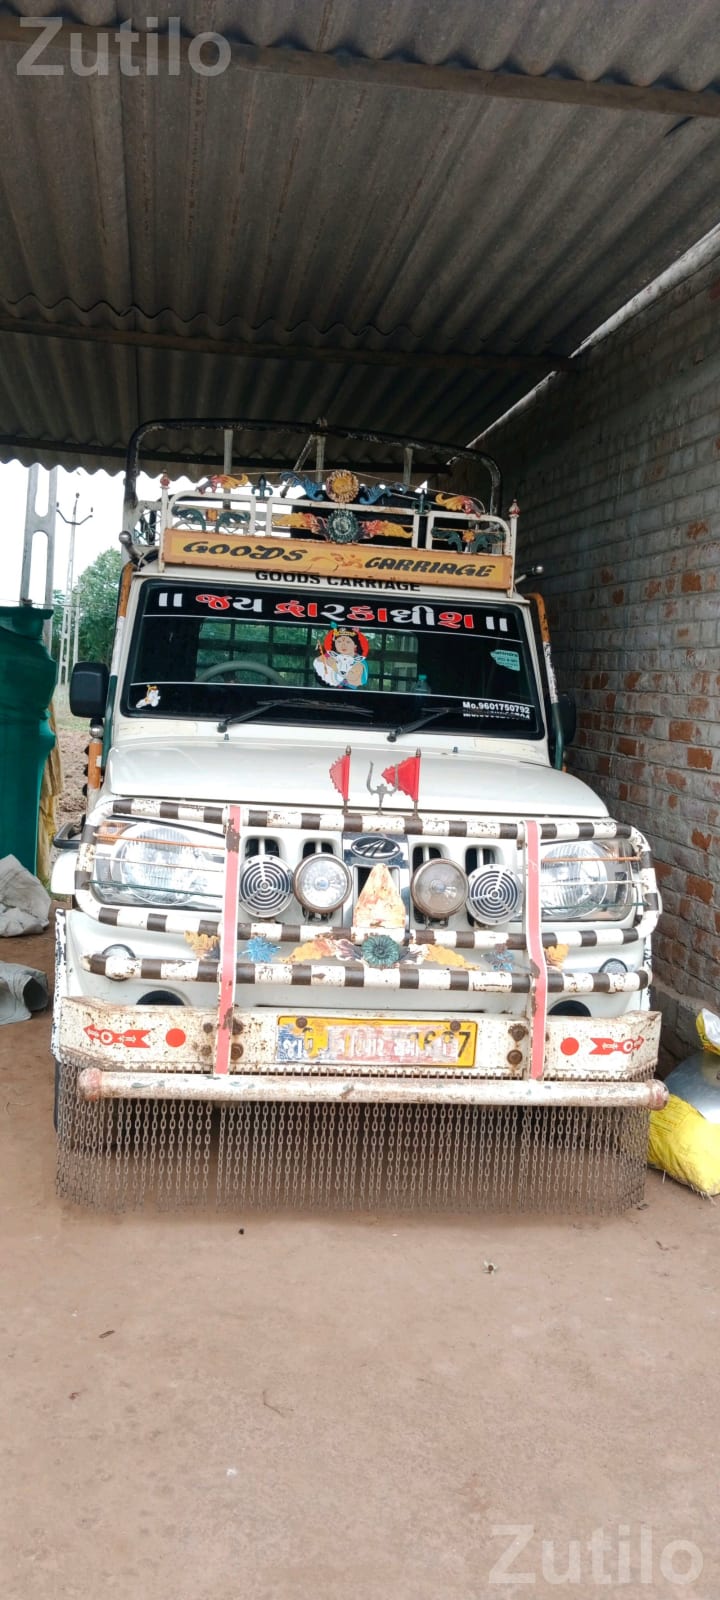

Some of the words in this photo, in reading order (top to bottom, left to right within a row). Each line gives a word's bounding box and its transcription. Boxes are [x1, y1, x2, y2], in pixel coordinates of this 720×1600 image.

[183, 541, 308, 561] GOODS
[364, 557, 496, 577] CARRIAGE
[255, 570, 320, 585] GOODS
[326, 576, 421, 592] CARRIAGE
[195, 593, 263, 613] જય
